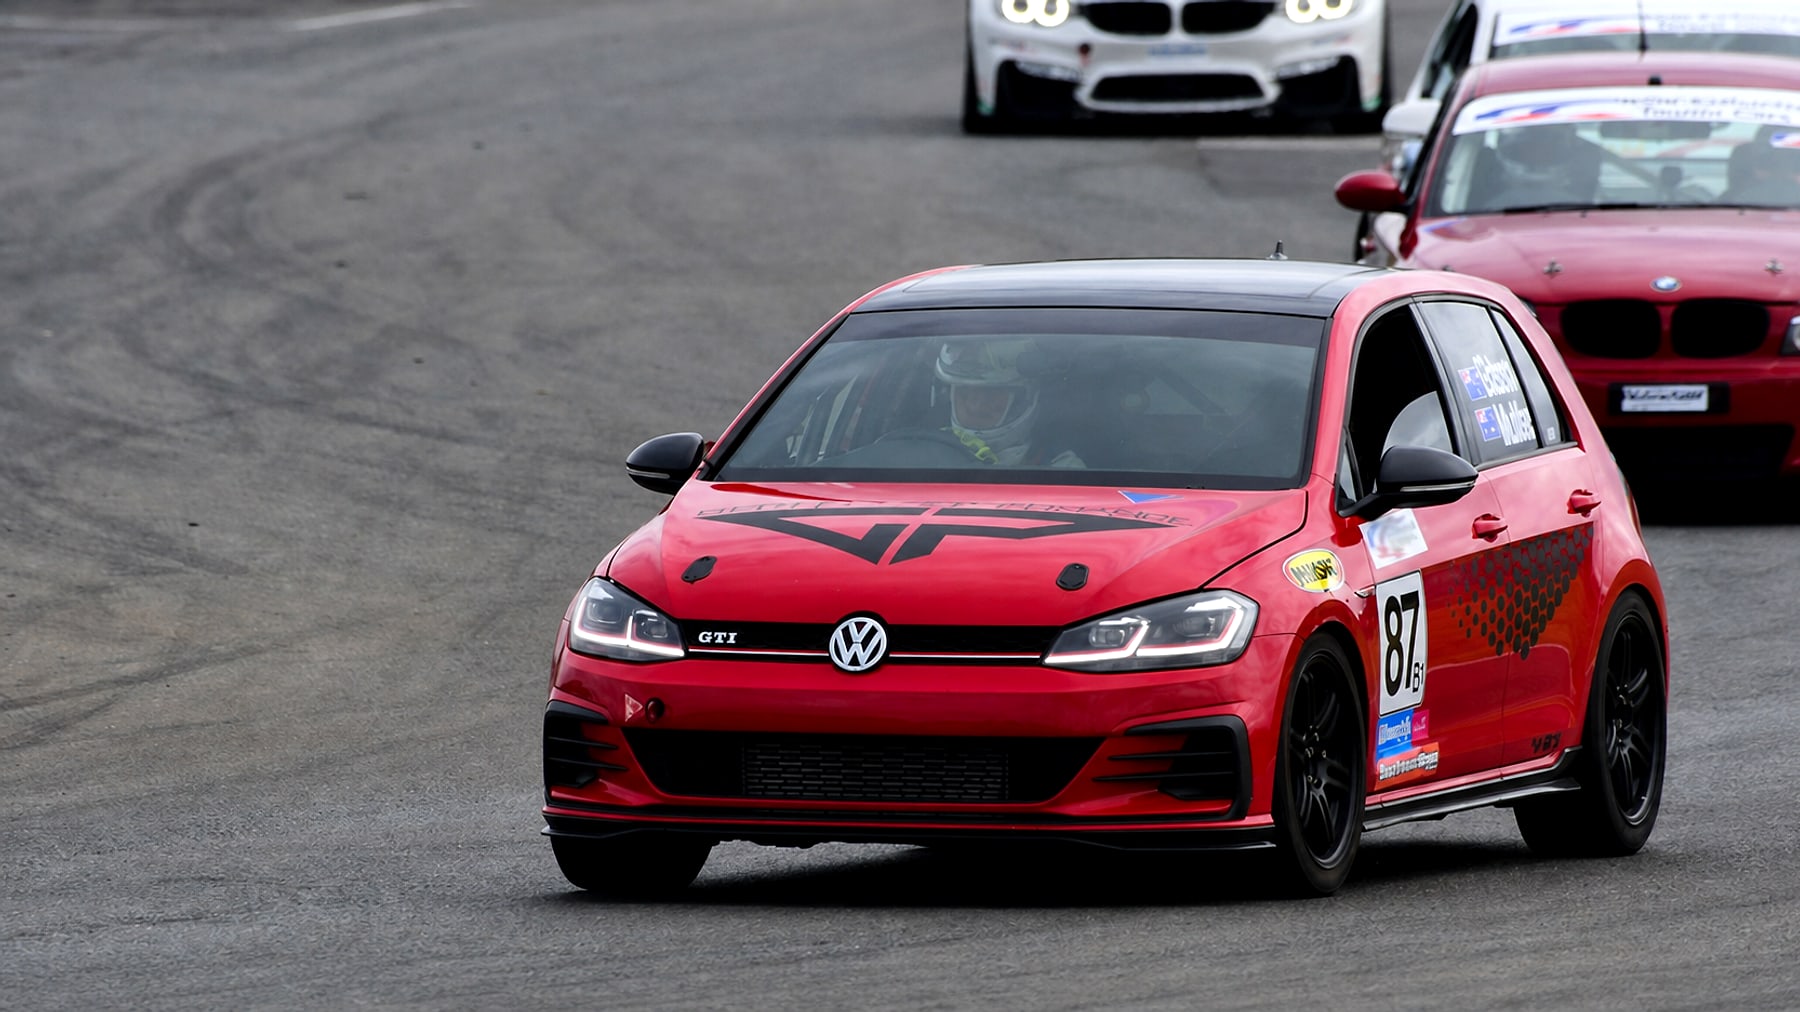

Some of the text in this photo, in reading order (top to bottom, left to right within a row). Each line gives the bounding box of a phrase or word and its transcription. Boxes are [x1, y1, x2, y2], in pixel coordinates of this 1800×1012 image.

[698, 631, 737, 644] GTI
[829, 617, 887, 671] VW
[1385, 590, 1420, 697] 87
[1412, 662, 1424, 693] B1
